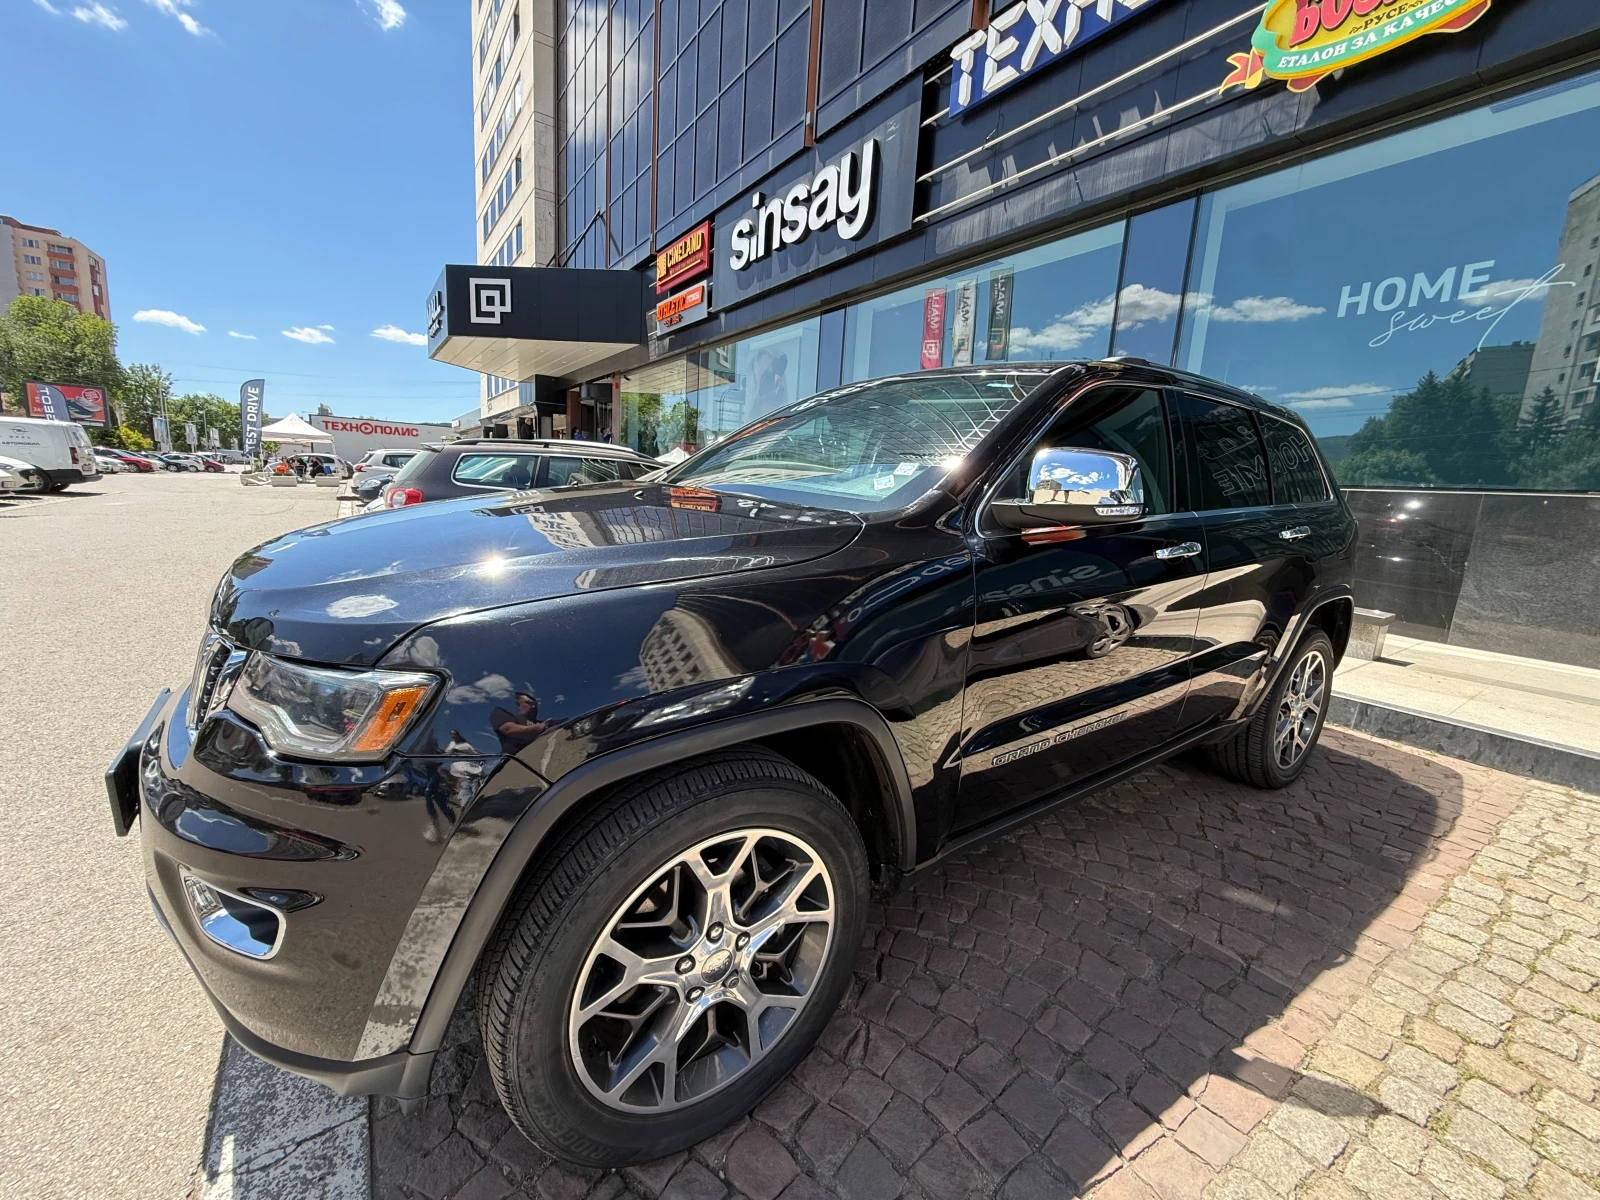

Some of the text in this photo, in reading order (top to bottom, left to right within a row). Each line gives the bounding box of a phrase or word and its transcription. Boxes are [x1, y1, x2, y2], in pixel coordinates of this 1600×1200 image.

[1363, 2, 1409, 31] РУСЕ
[1276, 41, 1346, 69] ЕТАЛОН
[1350, 32, 1378, 51] ЗА
[729, 138, 879, 271] sinsay
[666, 231, 704, 268] CINELAND
[1337, 259, 1496, 318] HOME
[1368, 263, 1577, 353] sweet
[247, 386, 259, 422] DRIVE
[245, 424, 257, 453] TEST
[322, 420, 419, 437] ТЕХНОПОЛИС
[992, 710, 1130, 767] GRAND CHEROKEE
